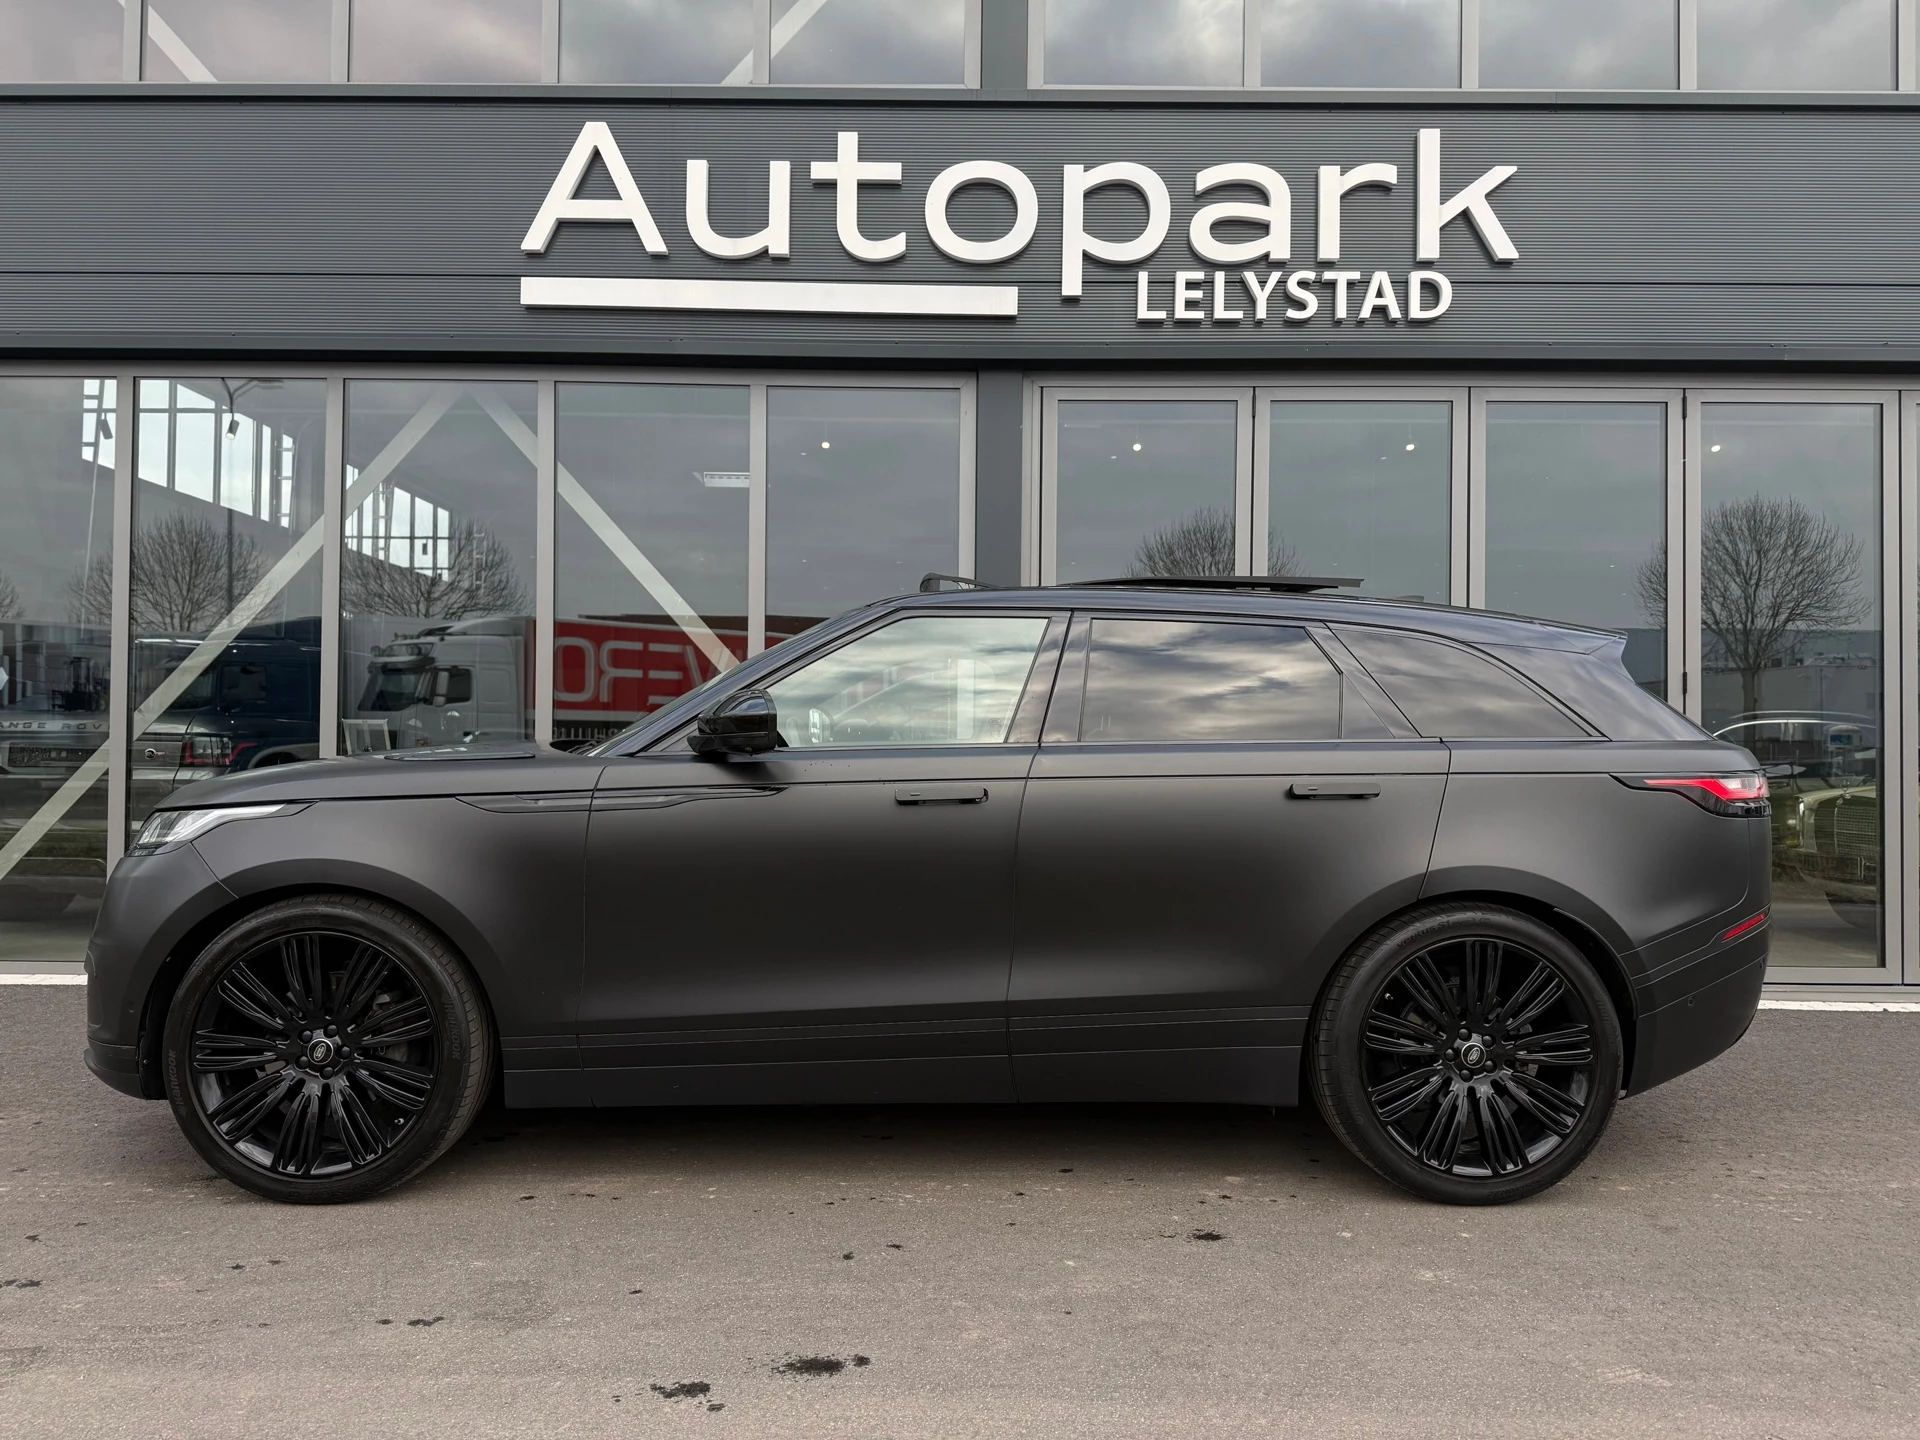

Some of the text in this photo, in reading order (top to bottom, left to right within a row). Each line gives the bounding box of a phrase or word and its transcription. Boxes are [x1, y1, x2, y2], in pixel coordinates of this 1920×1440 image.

[521, 120, 1519, 300] Autopark
[1135, 268, 1453, 325] LELYSTAD
[167, 1048, 185, 1105] Hankook
